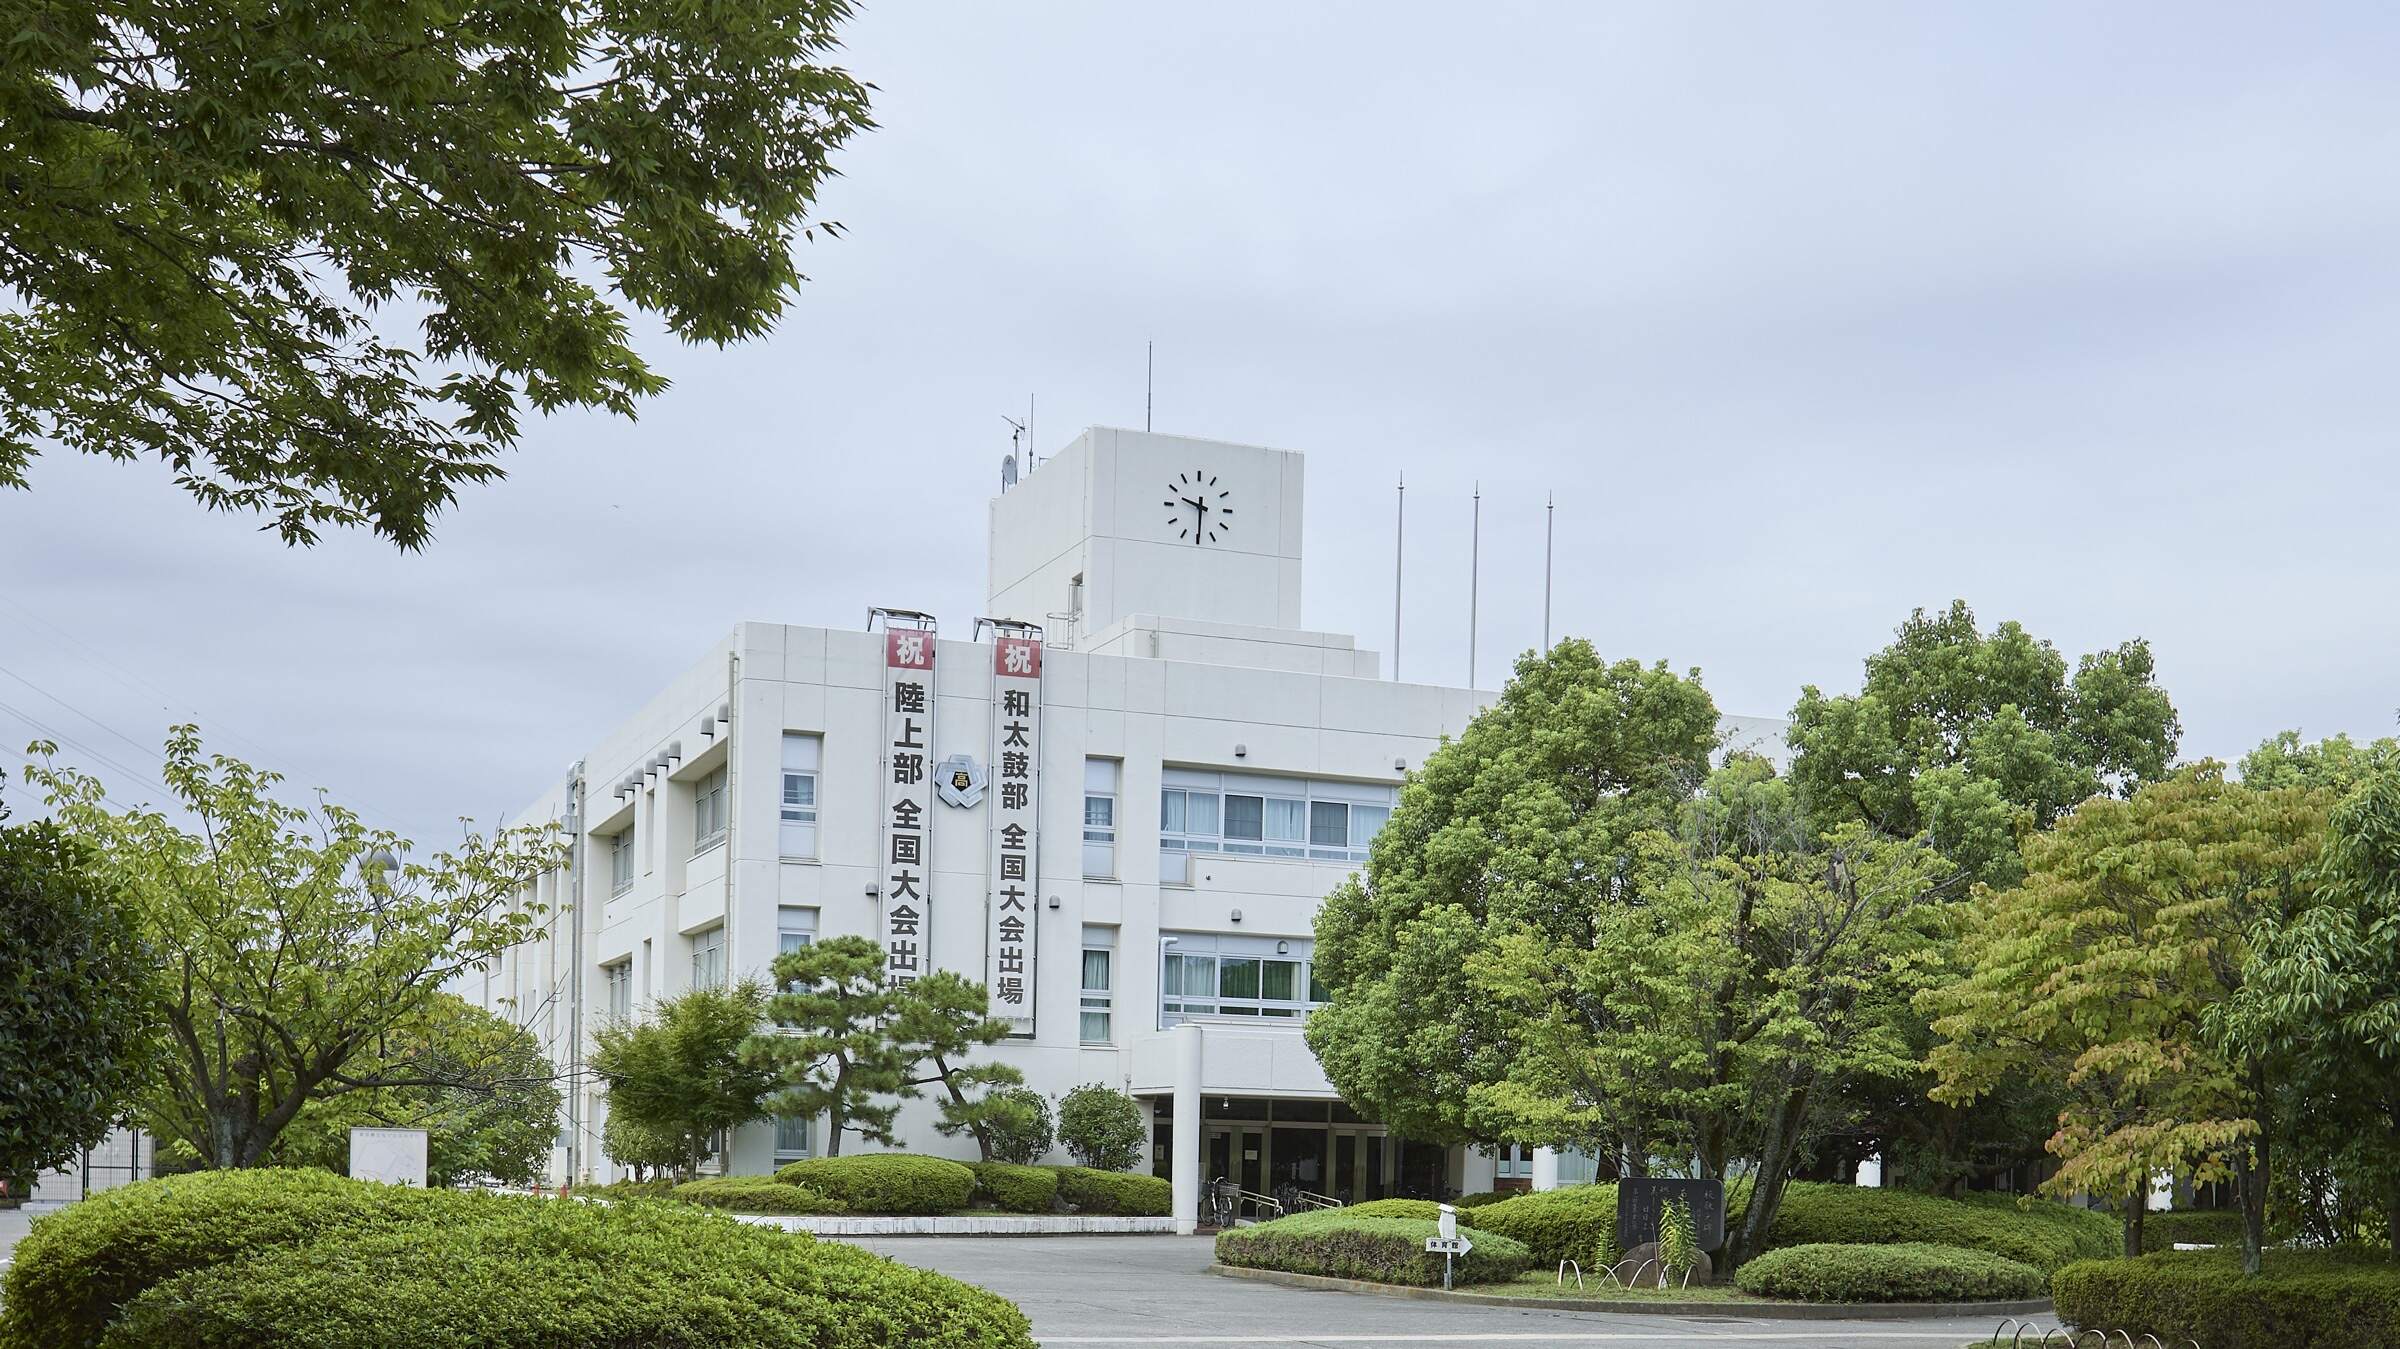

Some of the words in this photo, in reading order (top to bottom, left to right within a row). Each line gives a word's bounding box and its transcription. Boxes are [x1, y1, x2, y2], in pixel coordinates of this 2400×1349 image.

[896, 635, 925, 665] 祝
[1004, 643, 1032, 674] 祝
[893, 681, 925, 785] 陸上部
[1001, 689, 1030, 810] 和太鼓部
[954, 771, 968, 788] 高
[997, 822, 1028, 1005] 全国大会出場
[1430, 1240, 1460, 1249] 体育館
